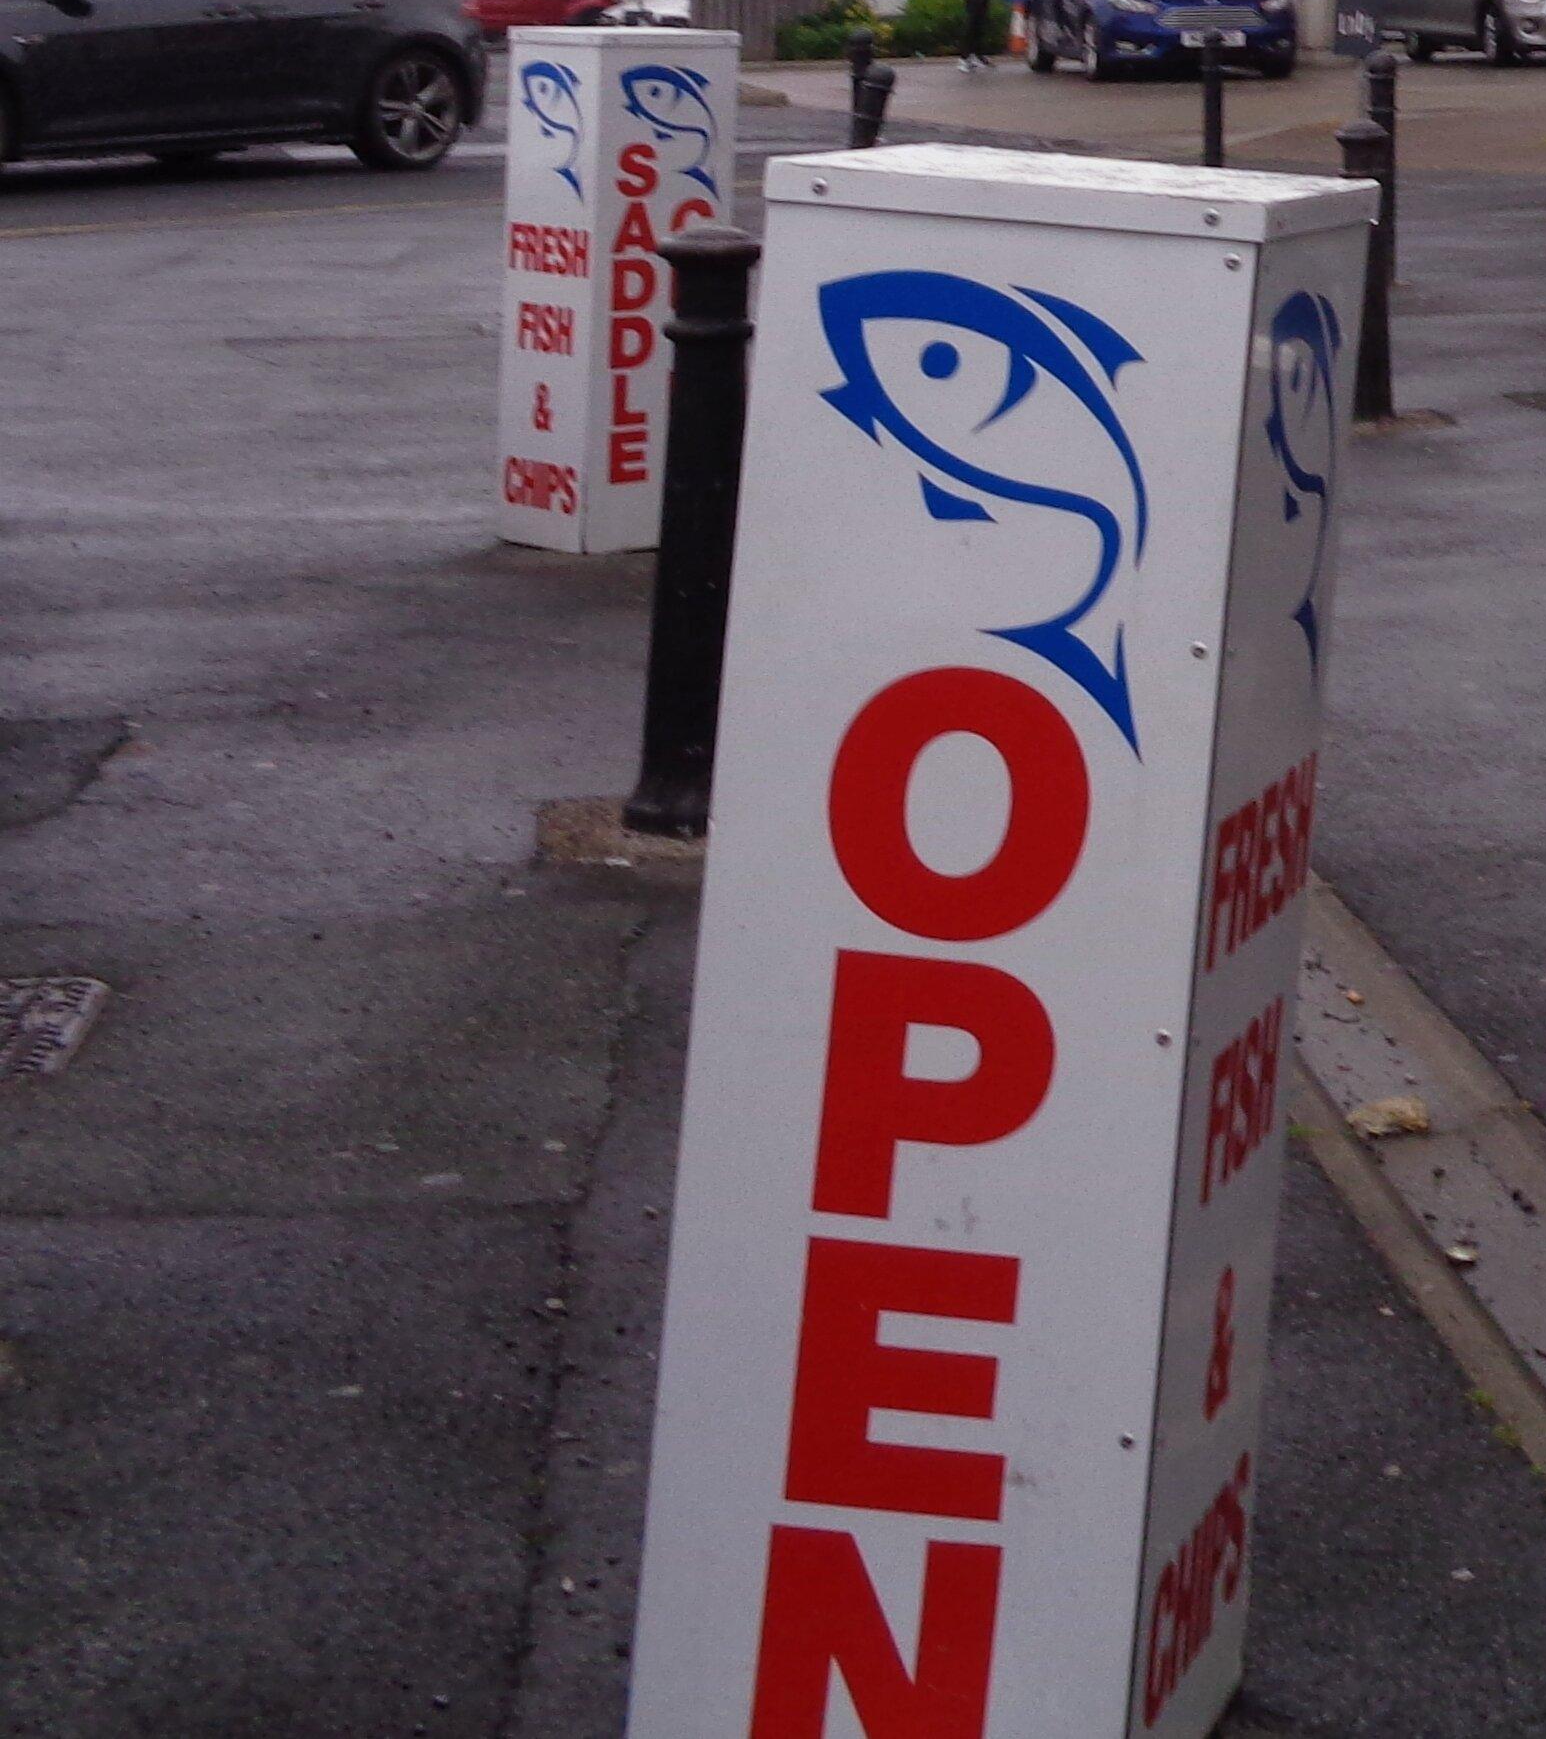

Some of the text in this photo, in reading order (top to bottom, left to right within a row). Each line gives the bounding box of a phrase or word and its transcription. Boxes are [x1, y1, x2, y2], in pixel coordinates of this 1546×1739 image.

[508, 221, 591, 279] FRESH
[517, 300, 576, 357] FISH
[607, 142, 660, 486] SADDLE
[503, 454, 579, 516] CHIPS
[533, 380, 553, 433] &
[1205, 750, 1318, 974] FRESH
[1199, 993, 1284, 1206] FISH
[746, 664, 1092, 1739] OPEN
[1202, 1264, 1237, 1424] &
[1142, 1451, 1252, 1730] CHIPS
